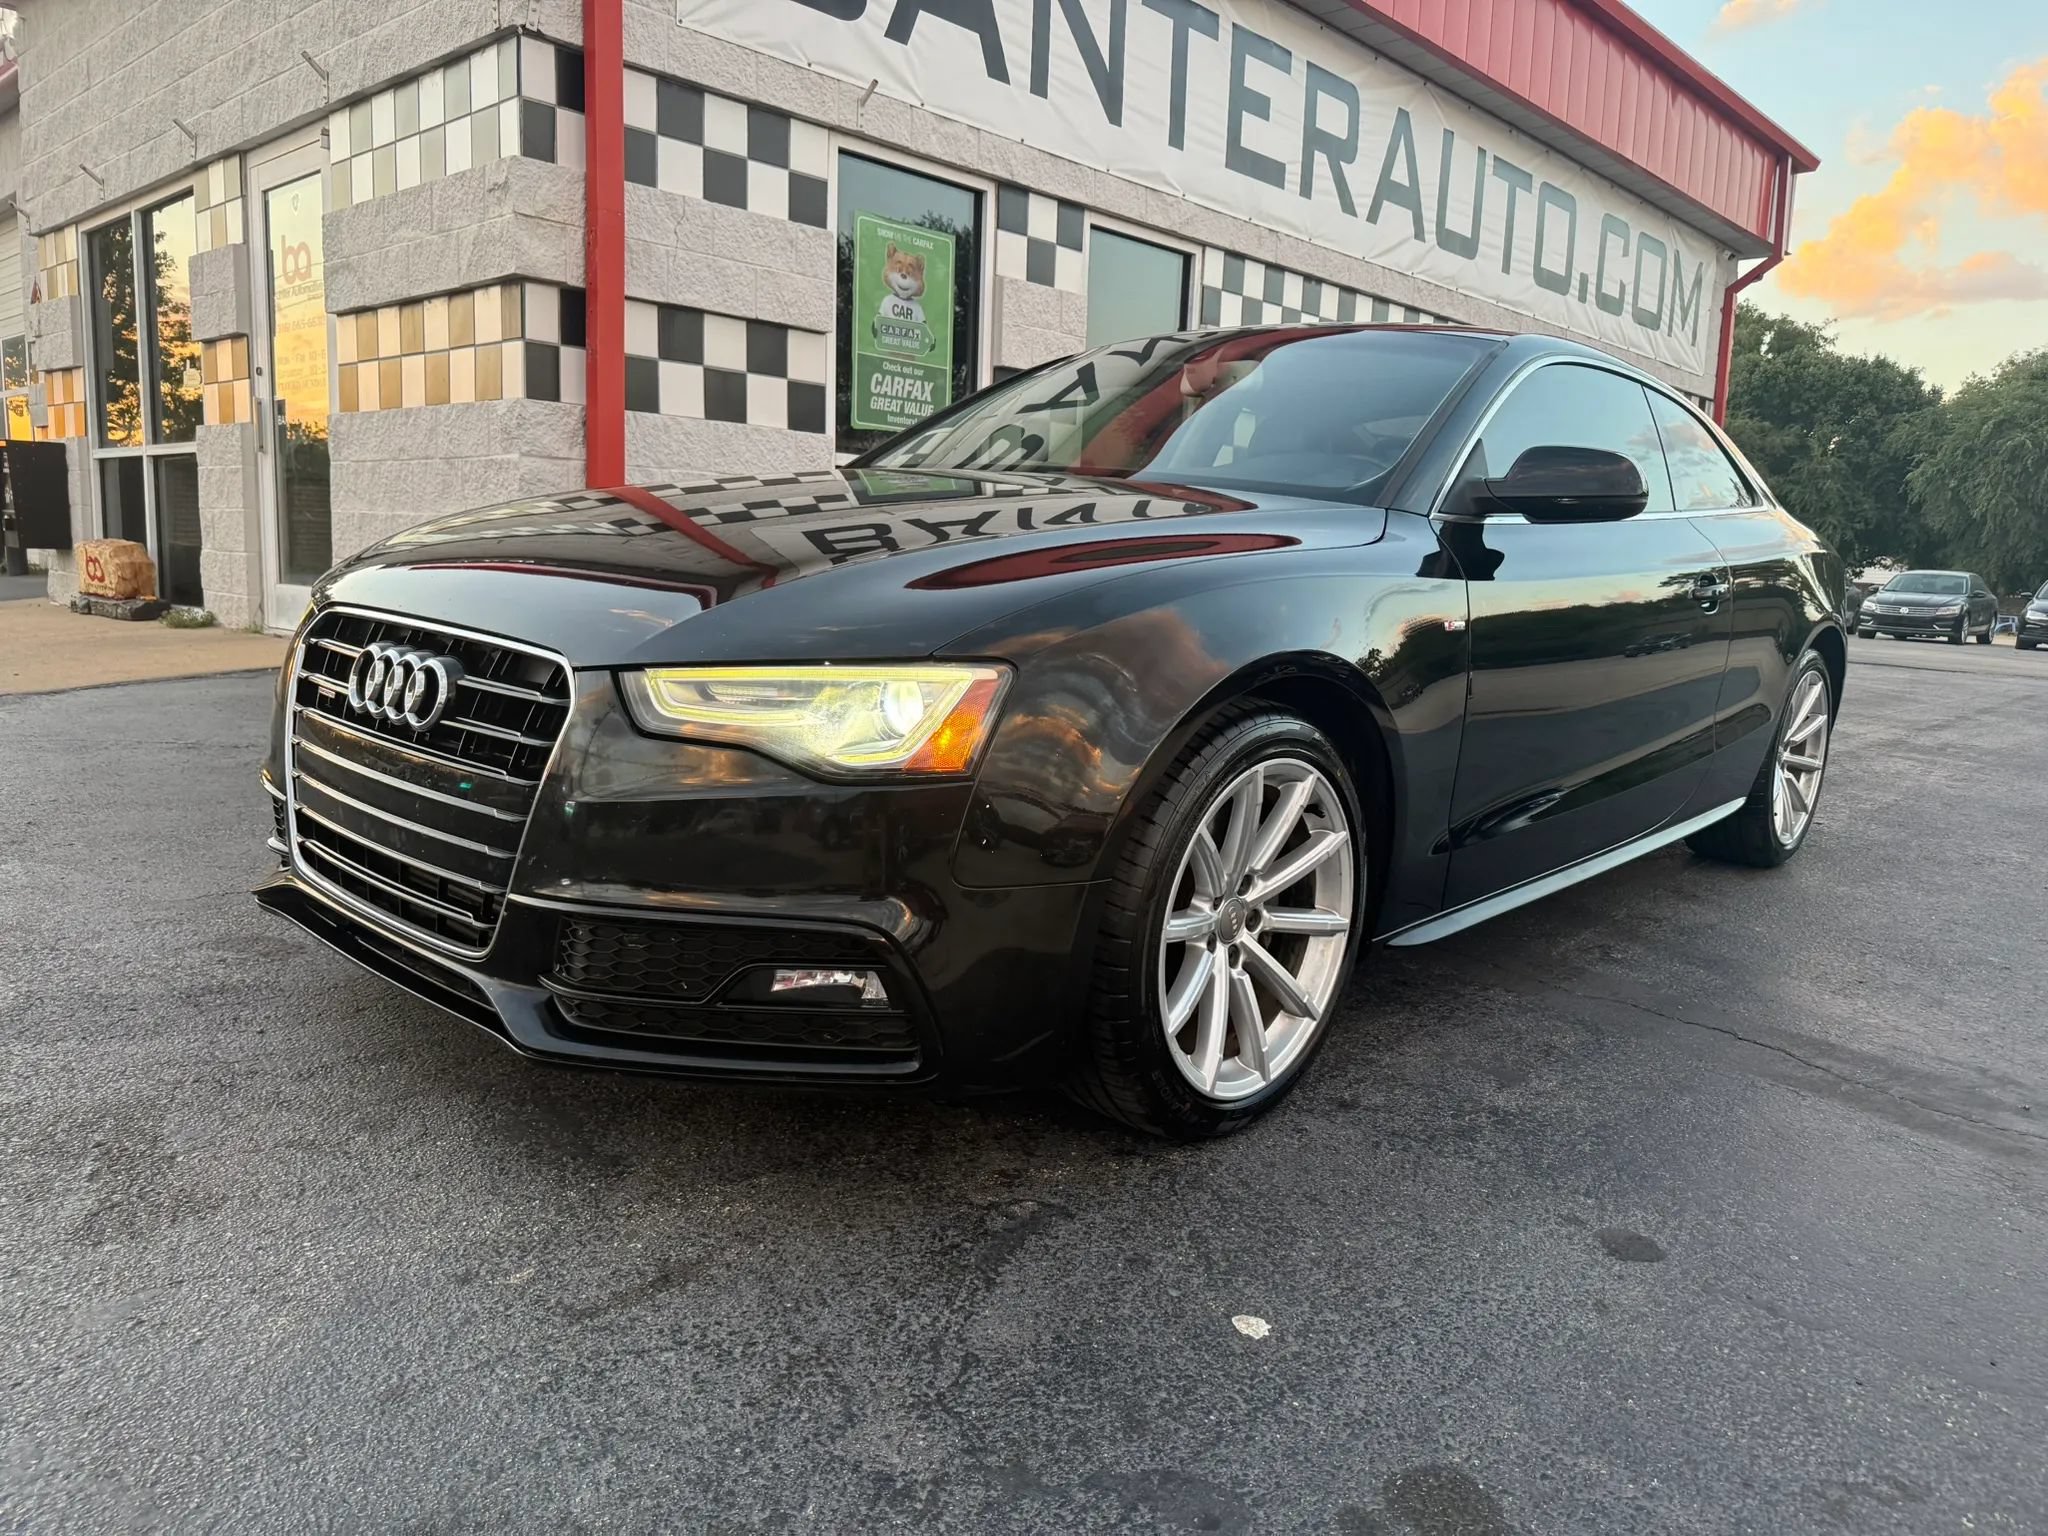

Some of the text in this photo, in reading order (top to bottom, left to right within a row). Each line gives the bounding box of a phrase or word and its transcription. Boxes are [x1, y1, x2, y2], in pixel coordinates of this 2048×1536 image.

[791, 0, 1703, 347] NTERAUTO.COM
[892, 303, 913, 320] CAR
[881, 324, 921, 340] CARFAX
[883, 361, 924, 376] Check out our
[870, 372, 934, 402] CARFAX
[870, 396, 934, 417] GREAT VALUE
